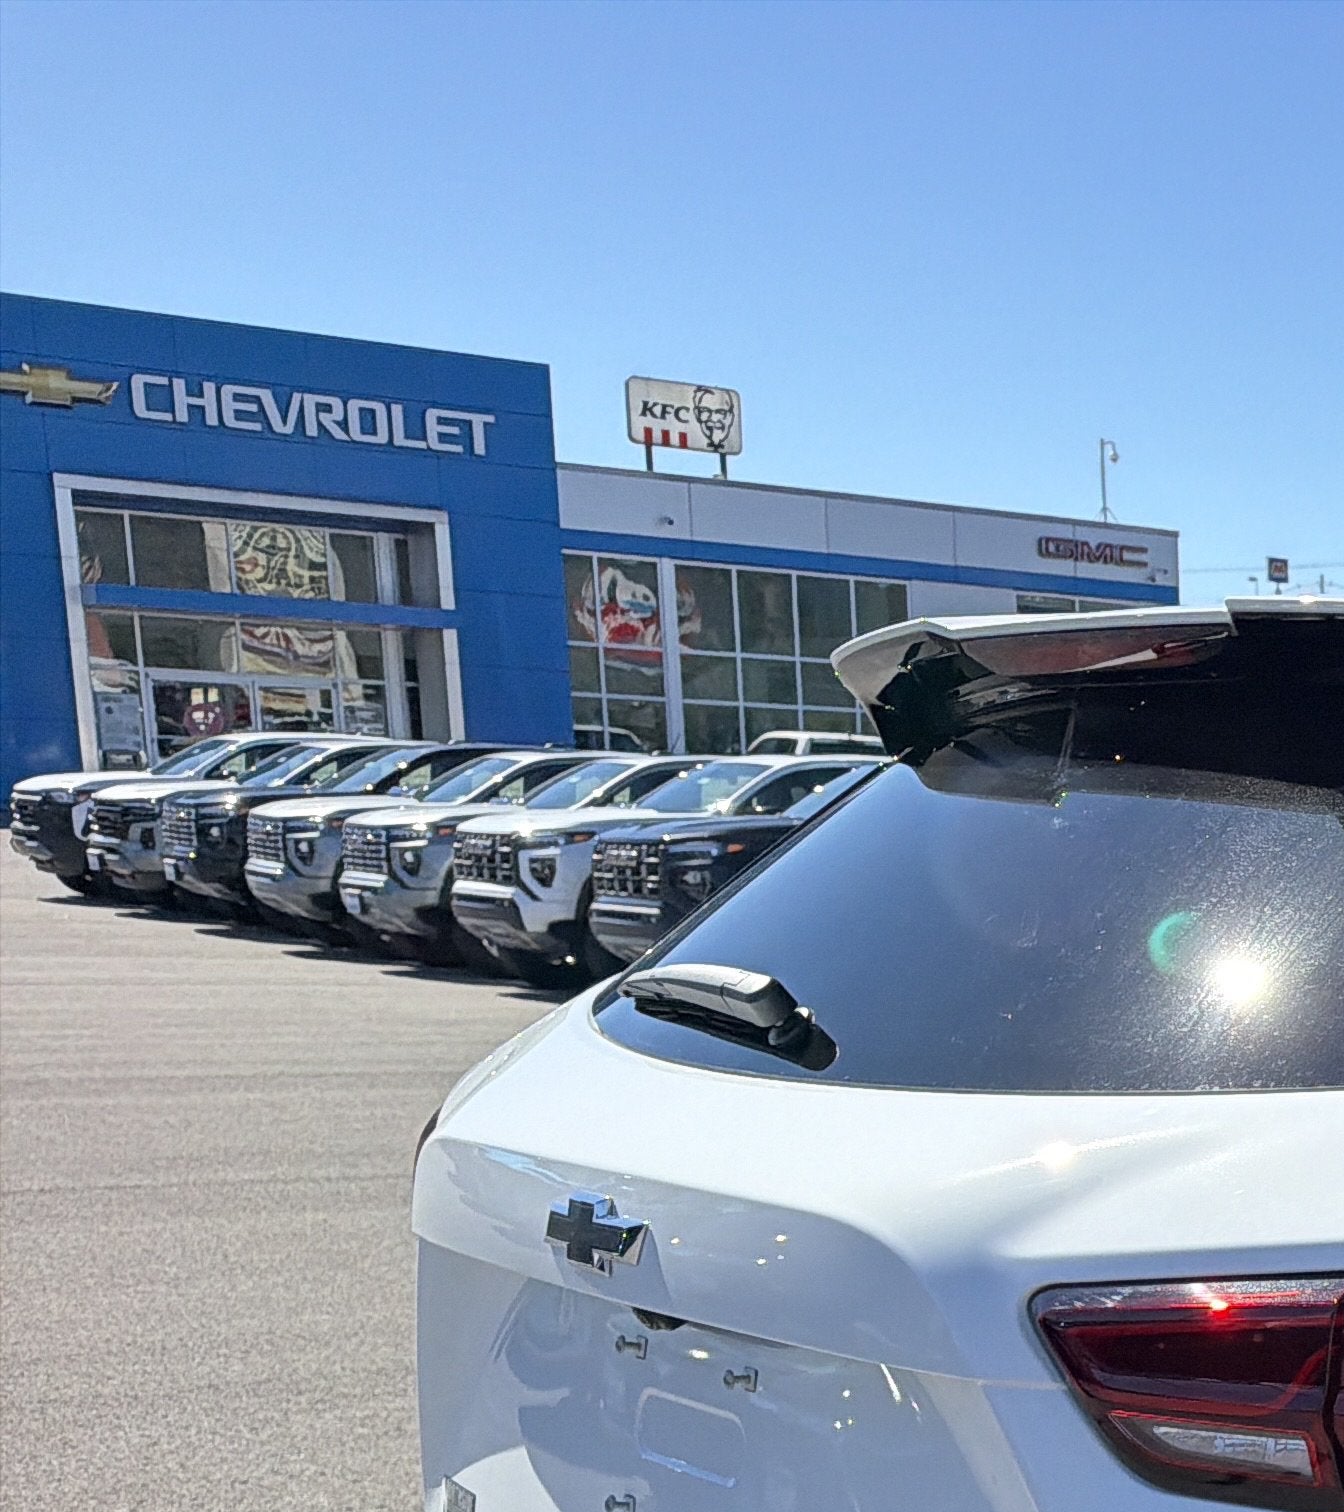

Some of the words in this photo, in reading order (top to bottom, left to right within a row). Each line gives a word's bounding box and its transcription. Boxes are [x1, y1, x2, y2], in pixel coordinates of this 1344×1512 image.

[131, 373, 495, 456] CHEVROLET
[639, 400, 690, 424] KFC
[1038, 536, 1148, 568] GMC
